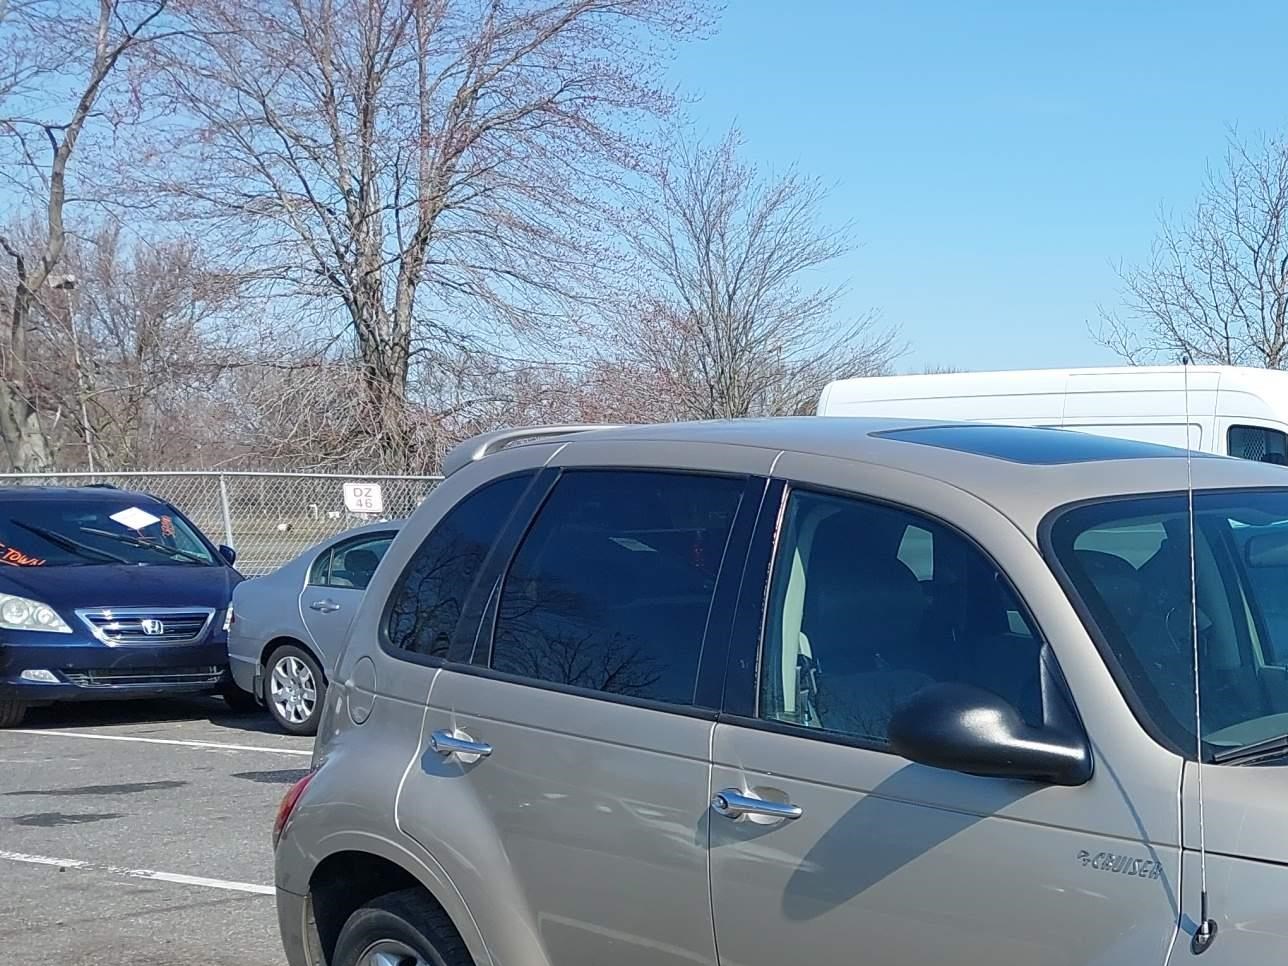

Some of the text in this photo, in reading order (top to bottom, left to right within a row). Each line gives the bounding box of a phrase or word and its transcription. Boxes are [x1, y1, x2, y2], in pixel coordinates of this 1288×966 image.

[353, 487, 373, 498] DZ
[355, 498, 373, 509] 46
[1091, 851, 1162, 880] CRUISER
